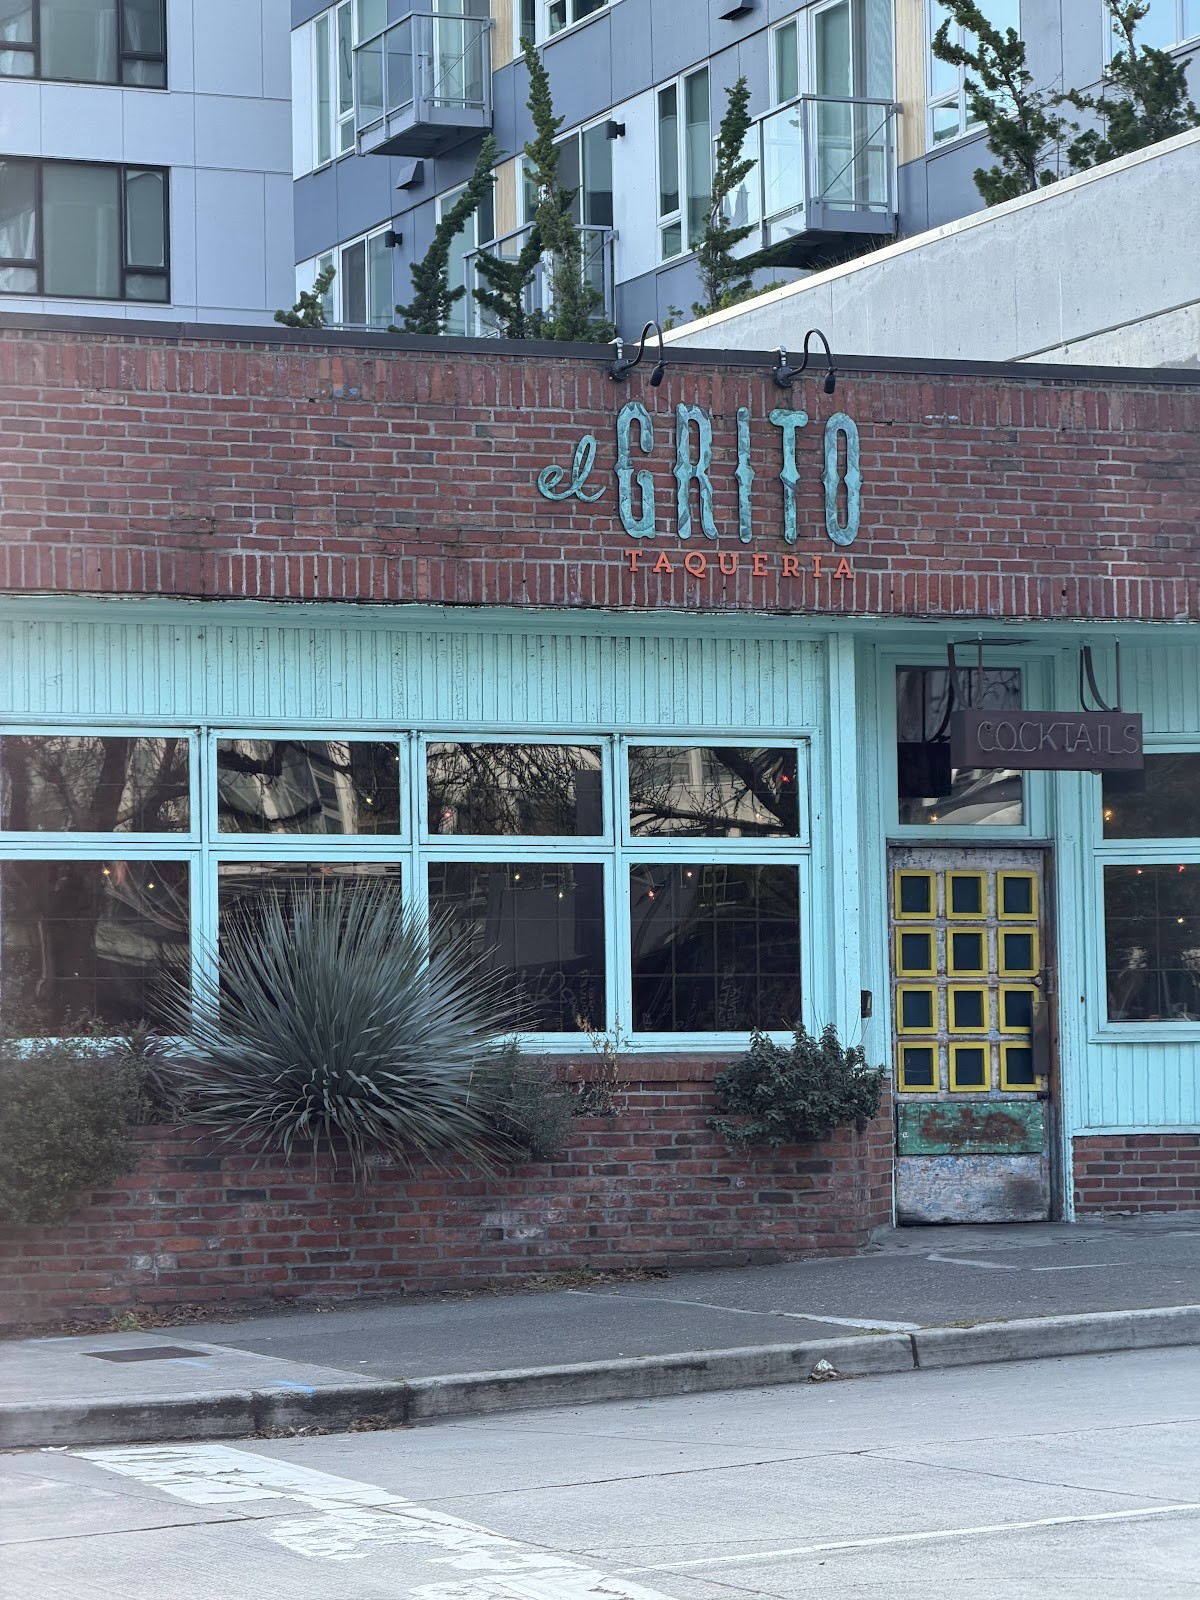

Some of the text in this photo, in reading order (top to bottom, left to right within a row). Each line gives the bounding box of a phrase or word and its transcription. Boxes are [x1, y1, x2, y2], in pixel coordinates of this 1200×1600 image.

[537, 402, 863, 546] el GRITO
[625, 550, 854, 579] TAQUERIA
[977, 721, 1140, 754] COCKTAILS
